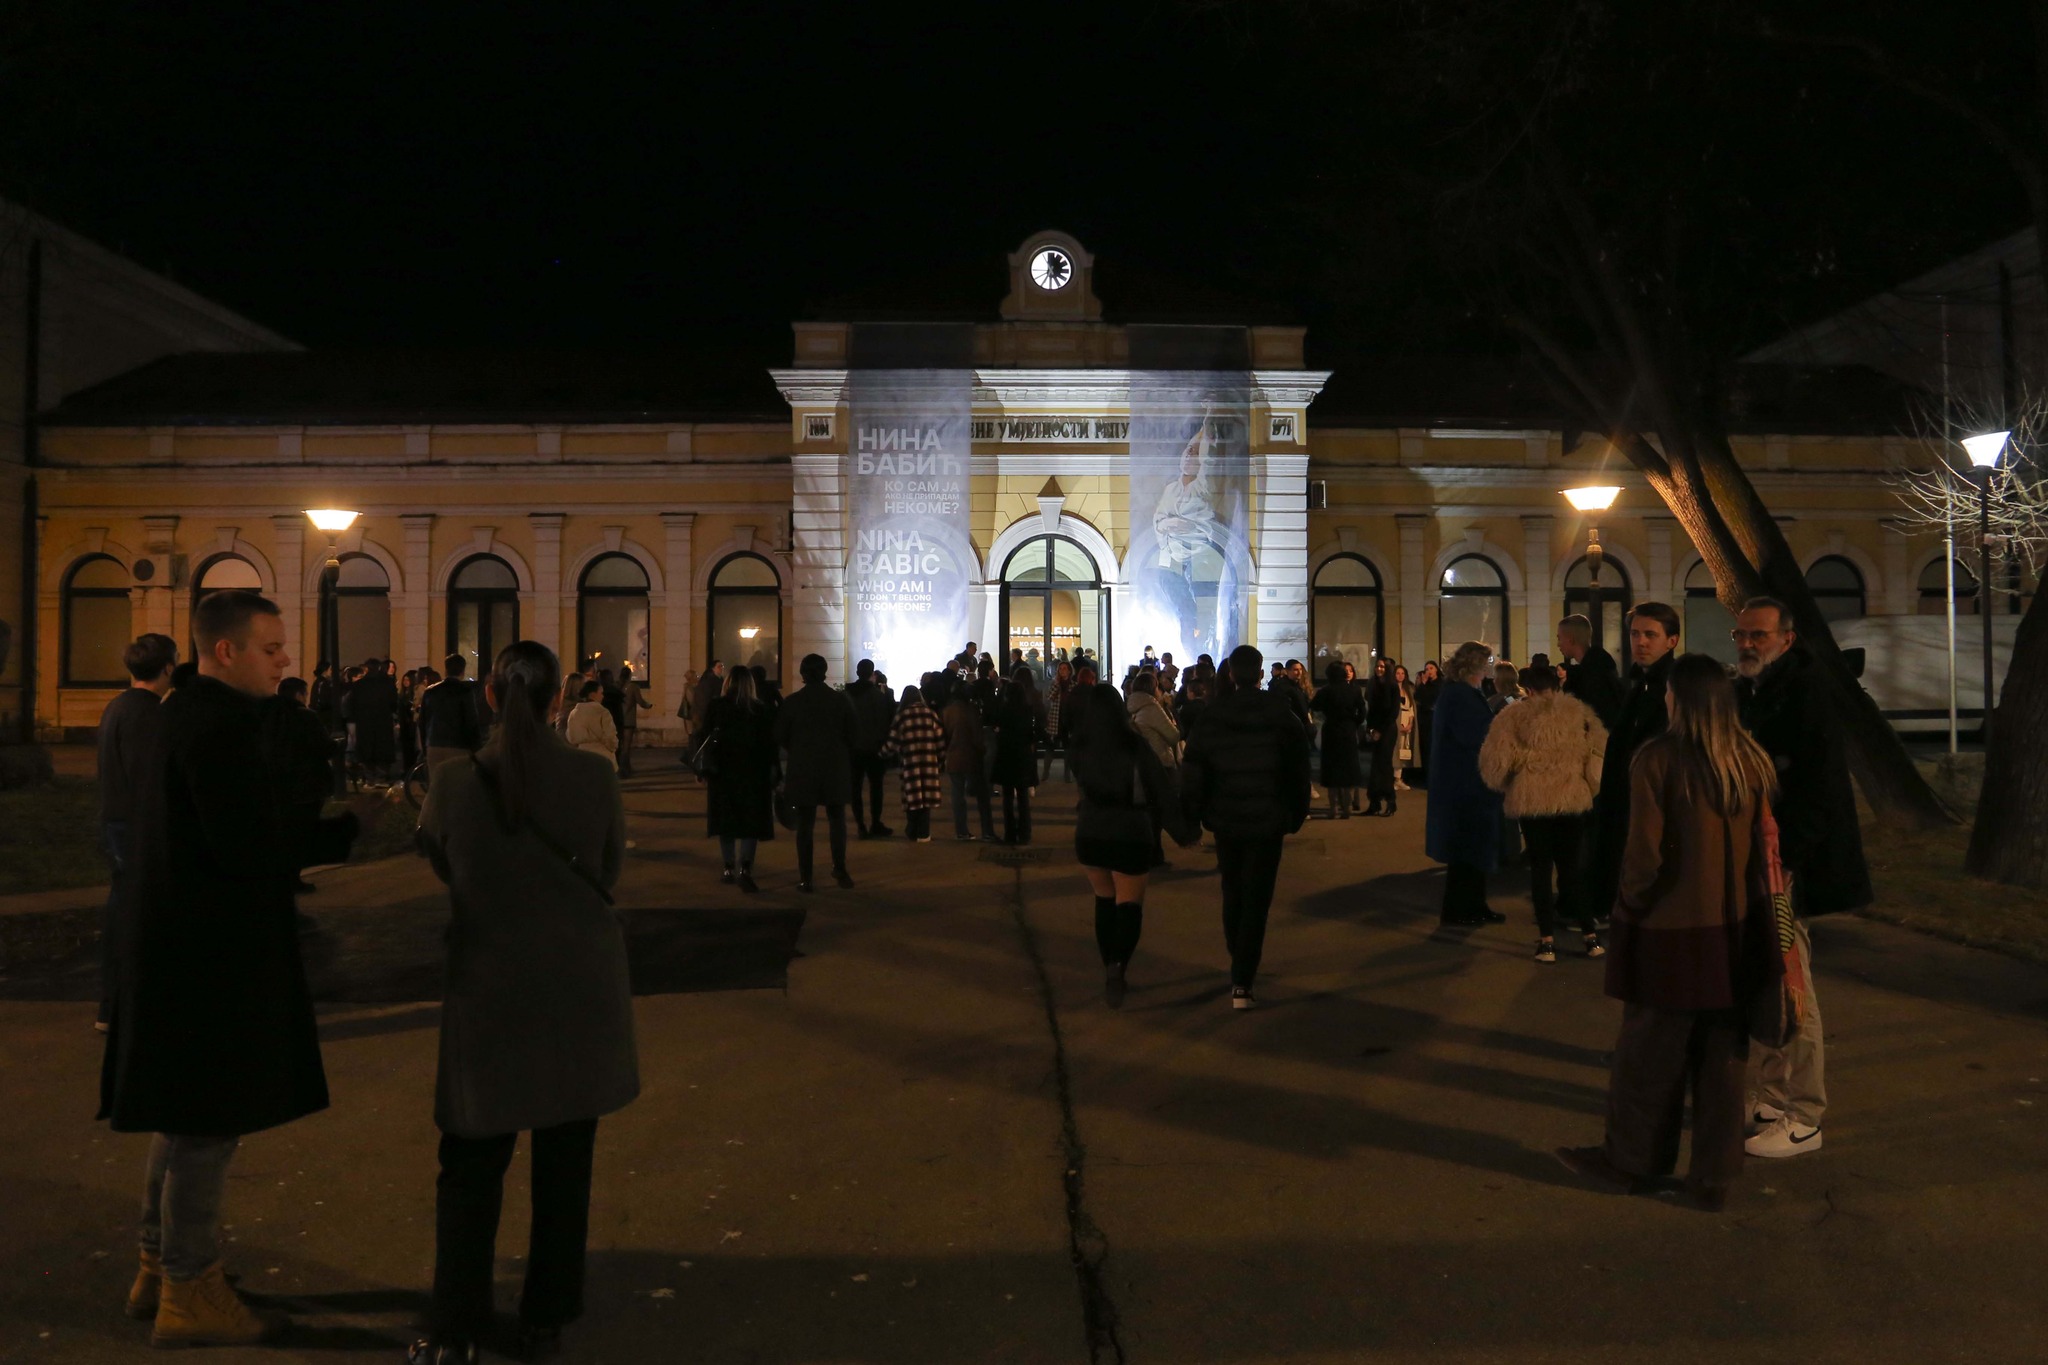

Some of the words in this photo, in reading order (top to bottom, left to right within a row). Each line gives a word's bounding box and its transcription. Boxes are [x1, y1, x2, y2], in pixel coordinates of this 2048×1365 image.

[858, 428, 942, 451] НИНА
[857, 452, 961, 476] БАБИЋ
[884, 480, 904, 492] КО
[907, 480, 939, 492] САМ
[942, 480, 960, 493] ЈА
[884, 501, 960, 514] НЕКОМЕ?
[857, 529, 924, 551] NINA
[857, 547, 941, 575] BABIĆ
[857, 580, 896, 592] WHO
[899, 580, 924, 593] AM
[928, 580, 932, 593] I
[857, 593, 864, 601] IF
[899, 593, 931, 601] BELONG
[857, 602, 872, 611] TO
[873, 602, 932, 612] SOMEONE?
